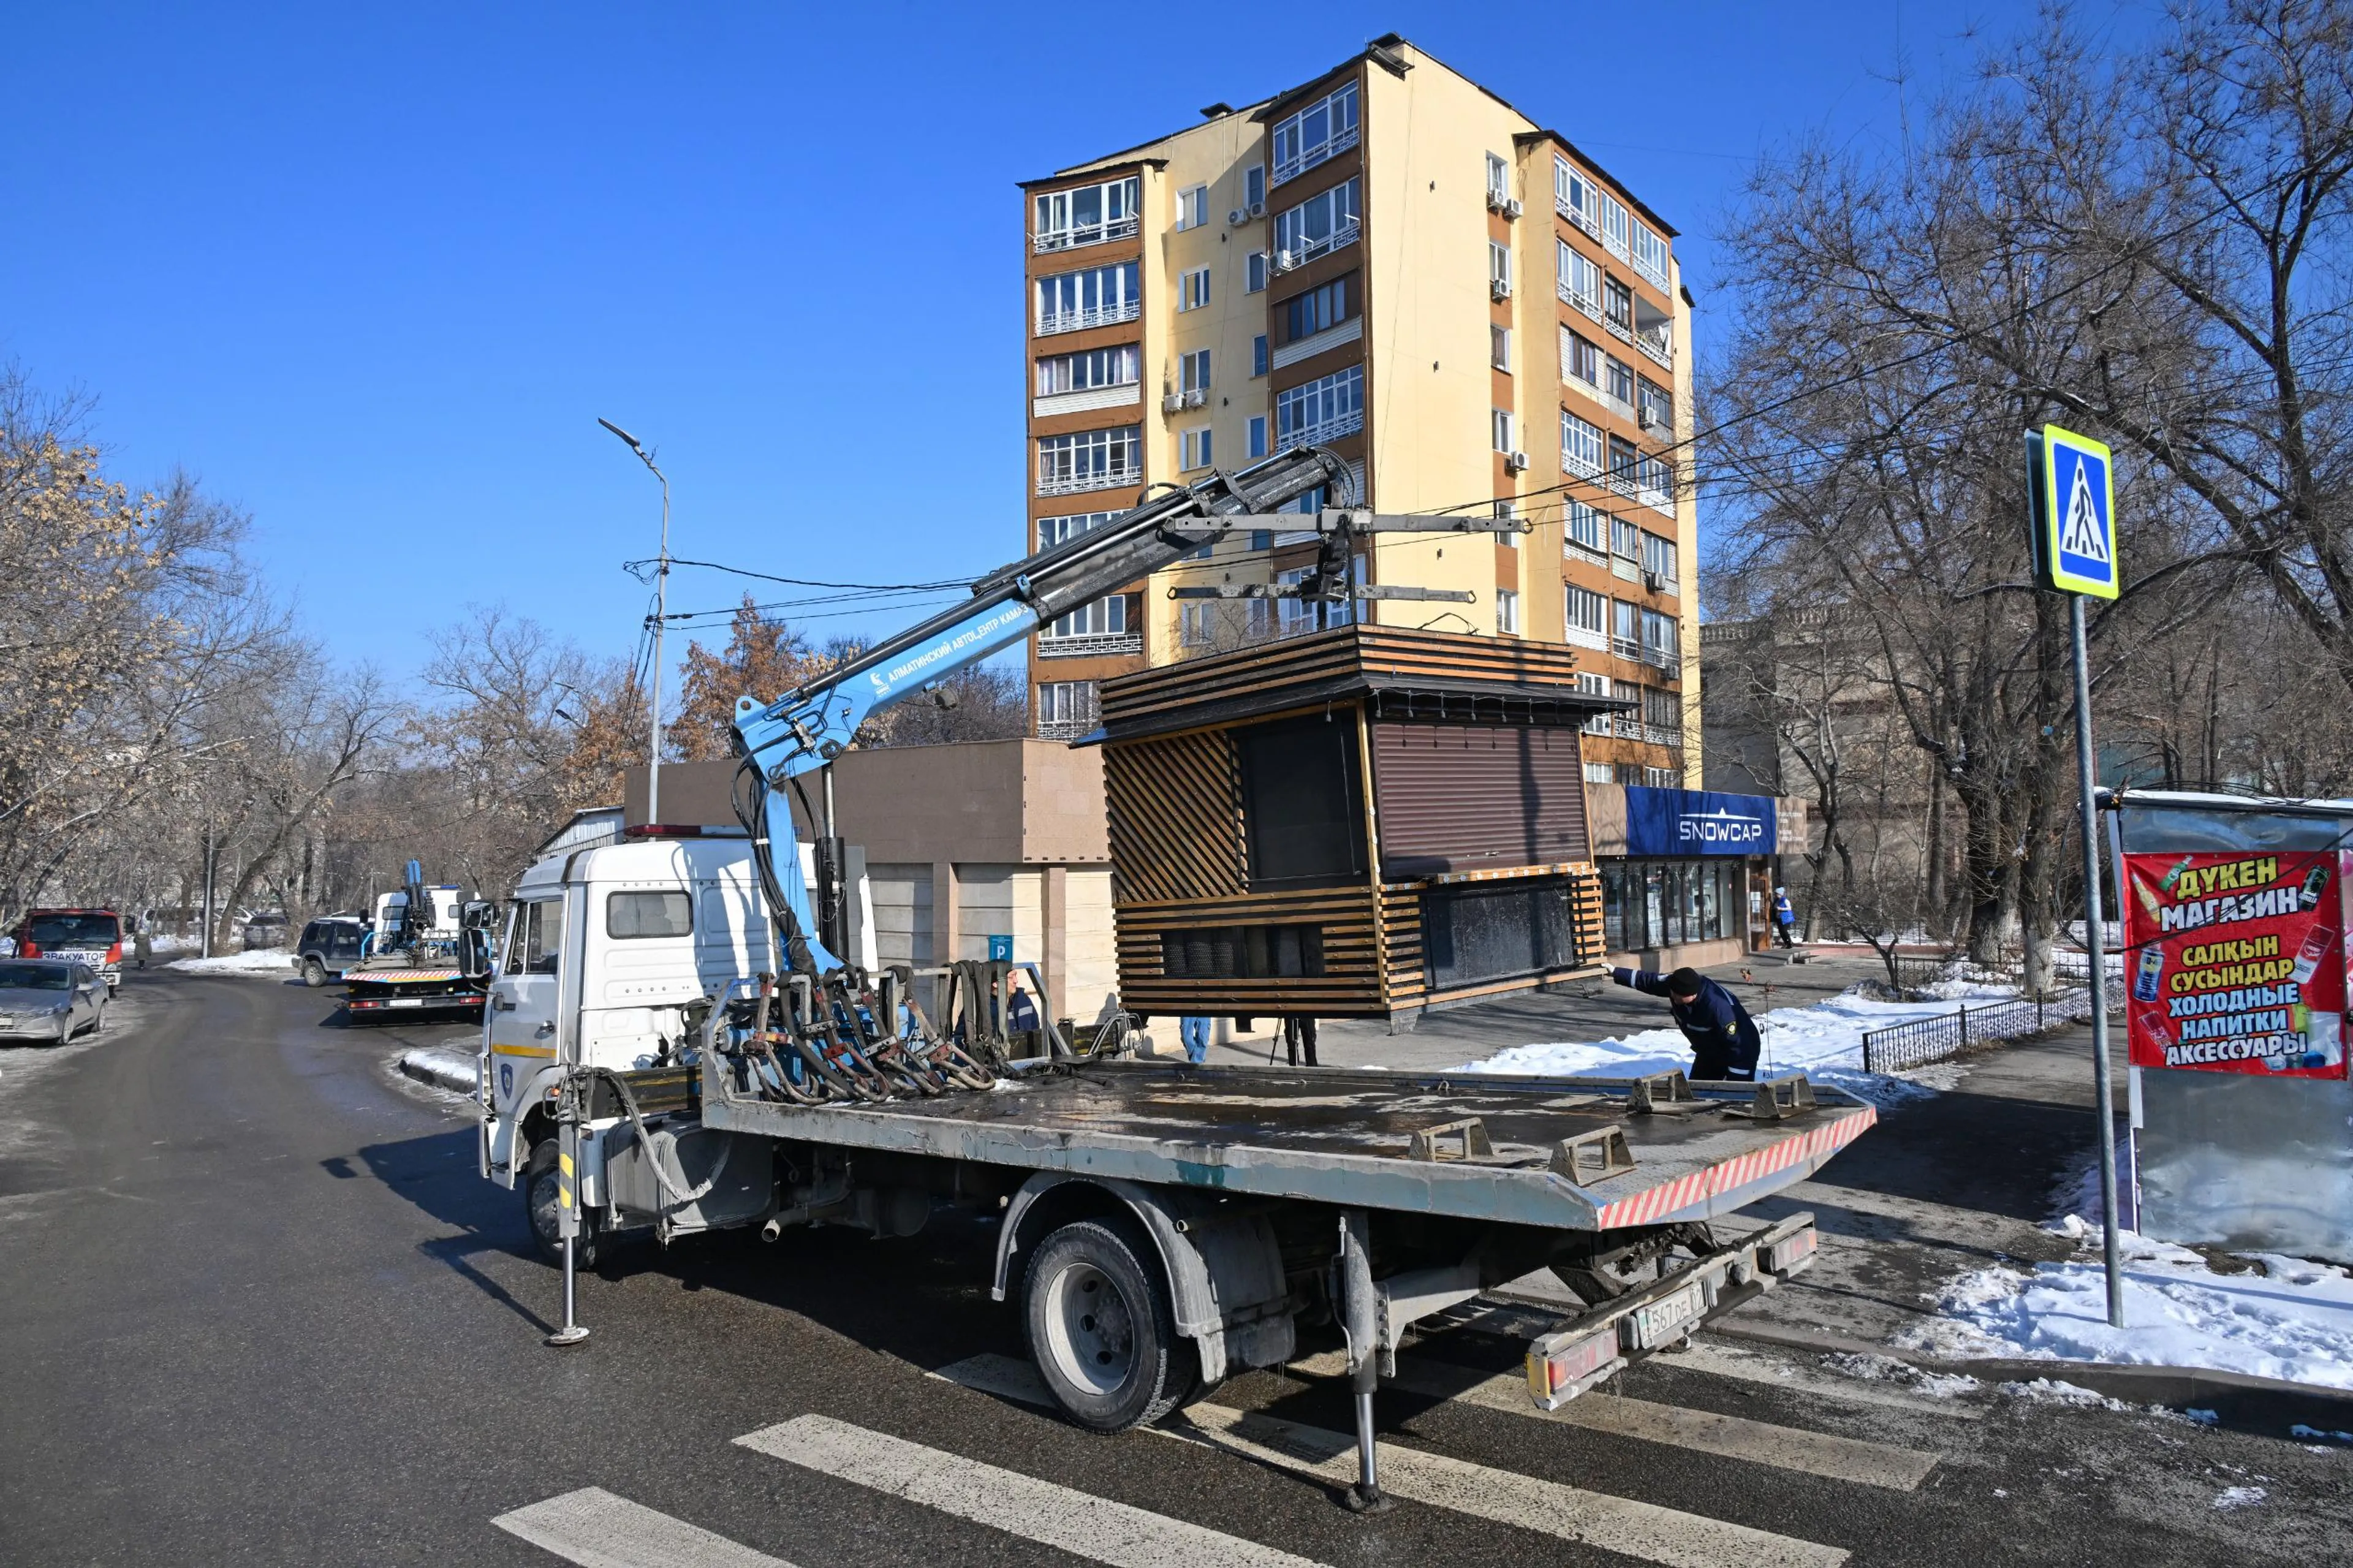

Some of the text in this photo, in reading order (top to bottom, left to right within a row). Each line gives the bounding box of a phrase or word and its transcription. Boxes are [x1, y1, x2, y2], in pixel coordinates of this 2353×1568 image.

[887, 604, 1029, 683] АЛМАТИНСКИЙ АВТОЦЕНТР КАМАЗ
[1680, 821, 1762, 841] SNOWCAP
[2159, 886, 2298, 932] МАГАЗИН
[43, 953, 105, 961] ЭВАКУАТОР
[997, 945, 1006, 959] P
[2181, 935, 2278, 968] САЛҚЫН
[2170, 958, 2295, 993] СУСЫНДАР
[2168, 983, 2299, 1018] ХОЛОДНЫЕ
[2181, 1009, 2287, 1040] НАПИТКИ
[2165, 1032, 2307, 1066] АКСЕССУАРЫ
[1652, 1303, 1672, 1333] 567
